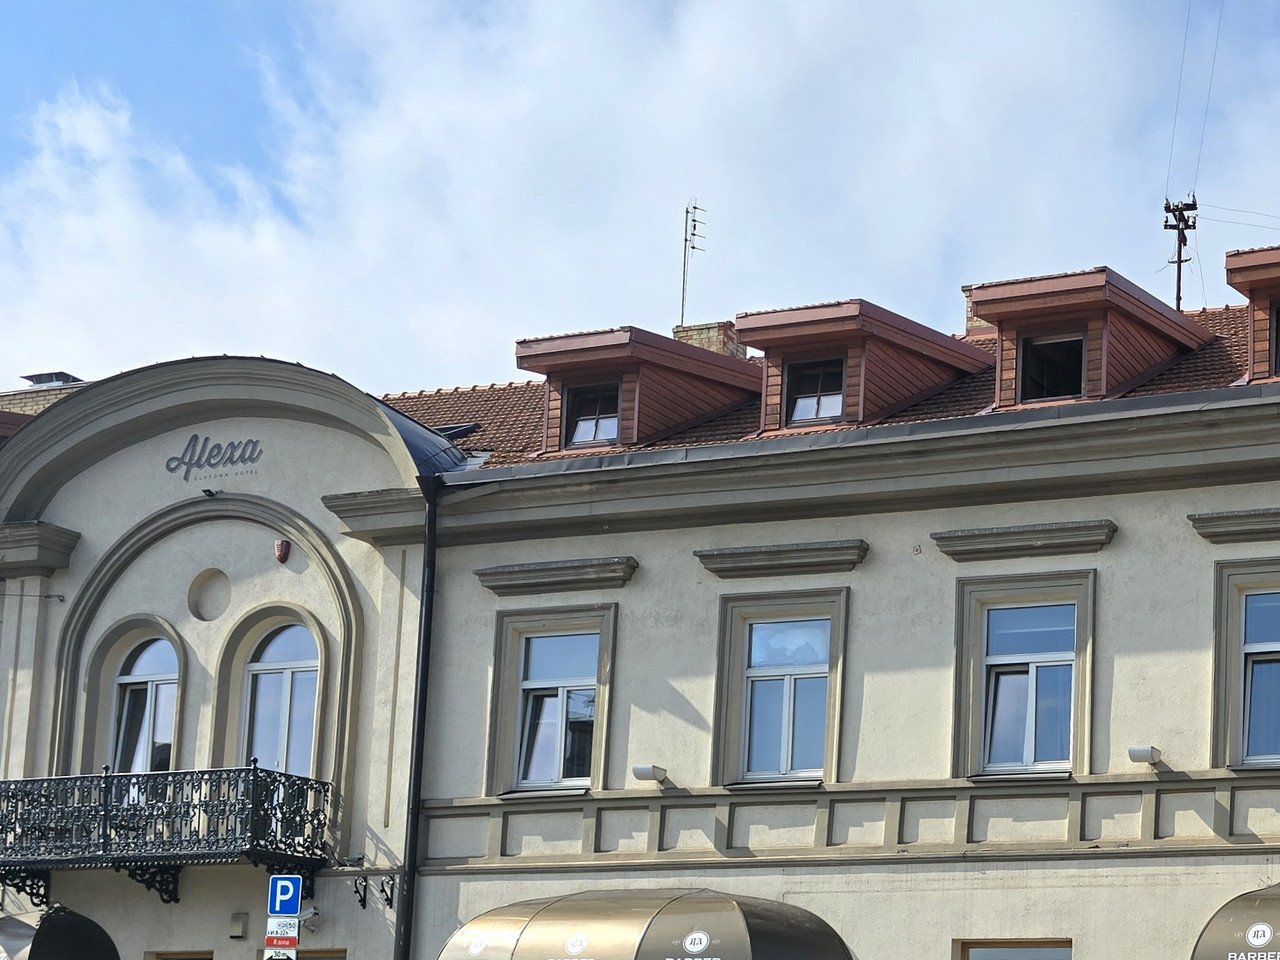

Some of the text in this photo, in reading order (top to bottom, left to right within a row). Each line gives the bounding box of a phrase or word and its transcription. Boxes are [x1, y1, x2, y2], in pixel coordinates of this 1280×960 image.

[166, 434, 263, 483] Alexa
[194, 473, 229, 482] OLDTOWN
[275, 881, 294, 911] P
